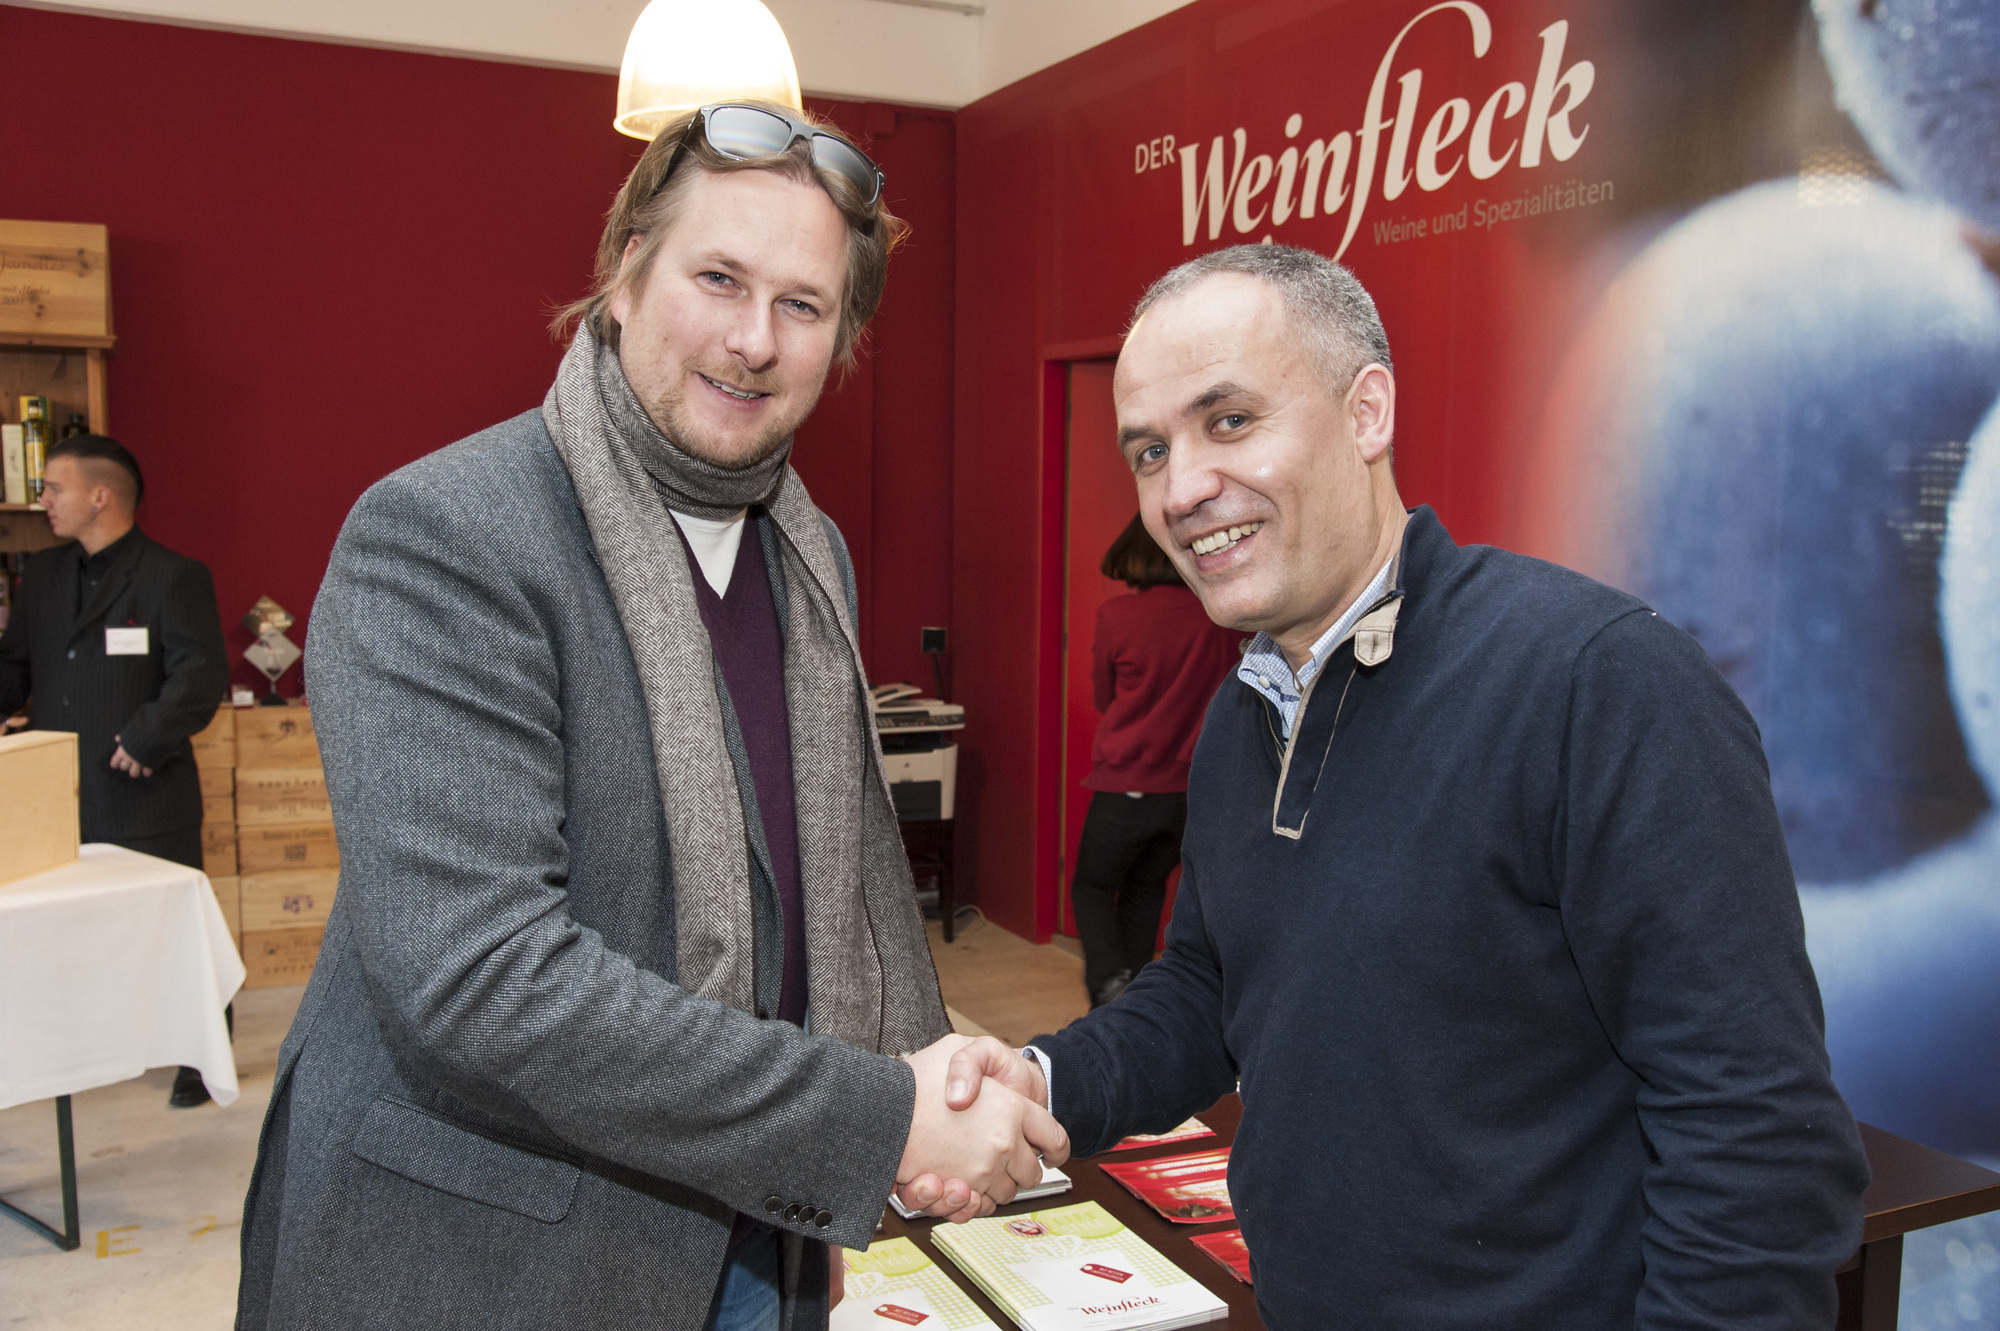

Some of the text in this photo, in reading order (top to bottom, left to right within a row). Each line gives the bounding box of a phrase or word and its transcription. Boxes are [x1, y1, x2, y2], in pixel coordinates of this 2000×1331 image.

[1135, 0, 1596, 262] DER Weinfleck
[1373, 179, 1615, 246] Weine und Spezialitäten
[1060, 1218, 1105, 1233] STYLE
[865, 1254, 913, 1271] STYLE
[1080, 1296, 1160, 1315] Weinfleck
